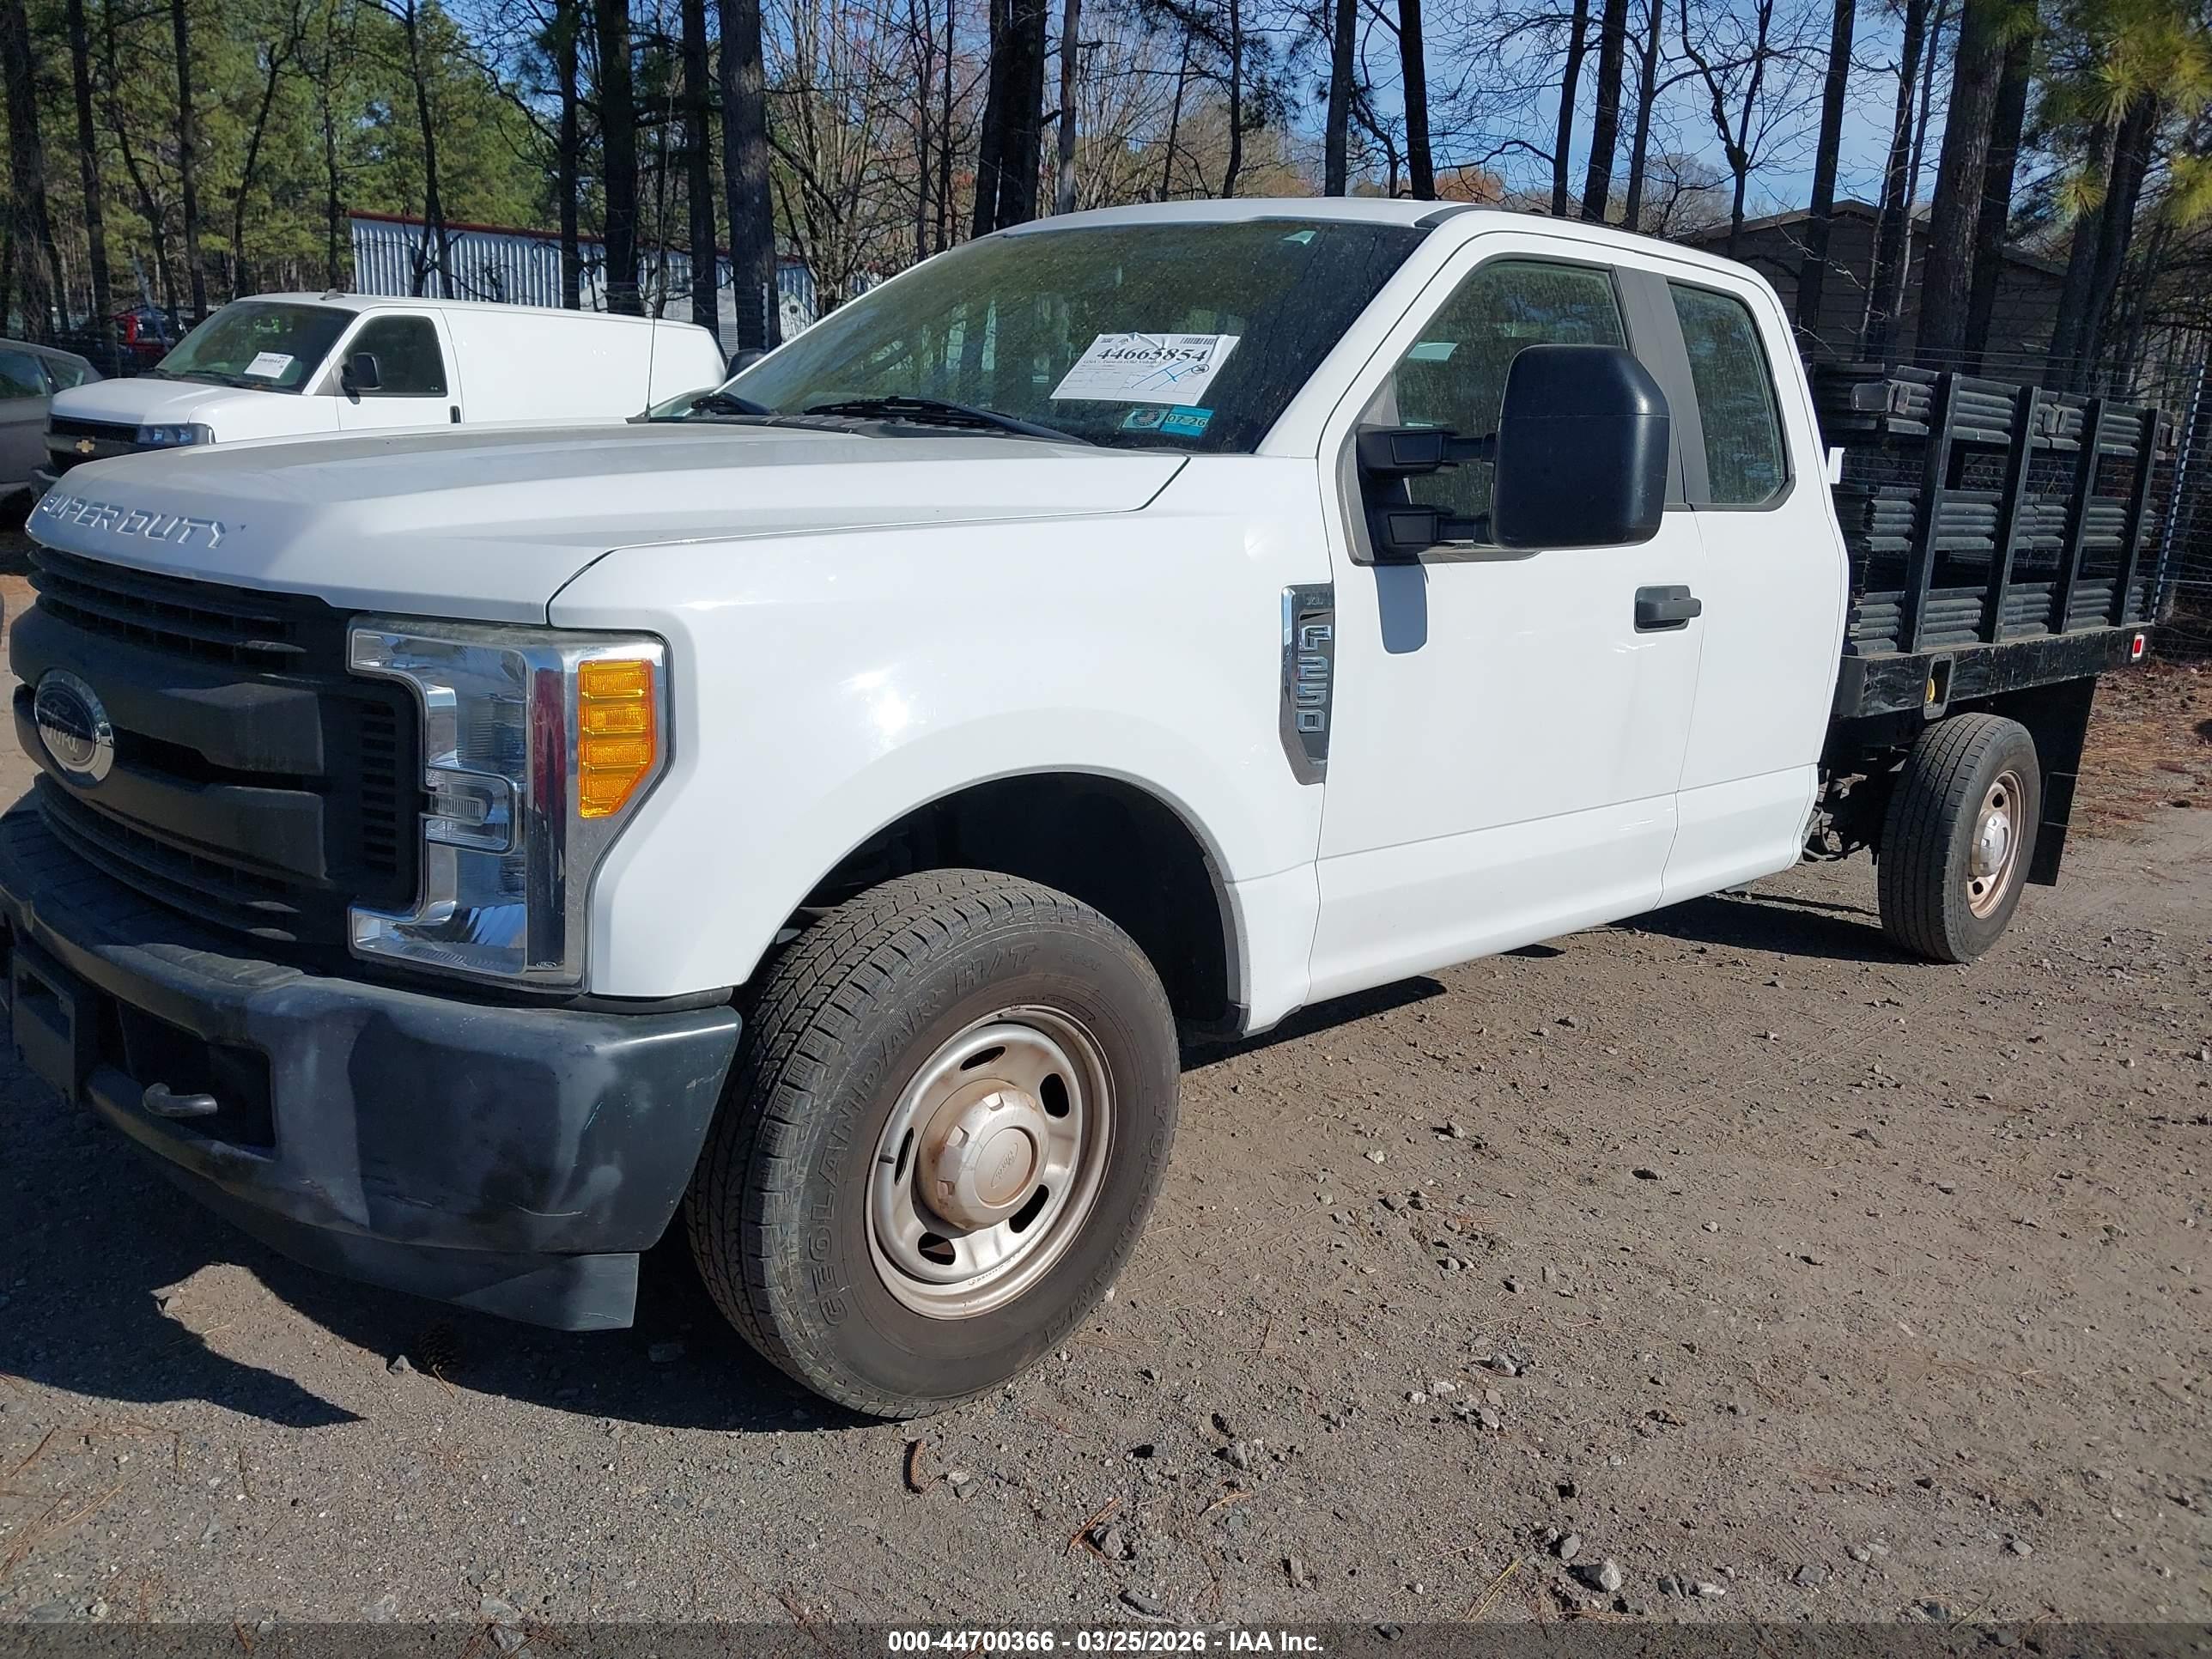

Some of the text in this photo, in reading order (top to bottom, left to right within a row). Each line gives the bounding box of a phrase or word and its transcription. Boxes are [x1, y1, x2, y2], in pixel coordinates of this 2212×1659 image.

[1097, 346, 1208, 362] 44665854
[1167, 415, 1184, 423] 07
[1189, 417, 1206, 426] 26
[116, 508, 226, 549] DUTY
[1297, 624, 1332, 732] F250
